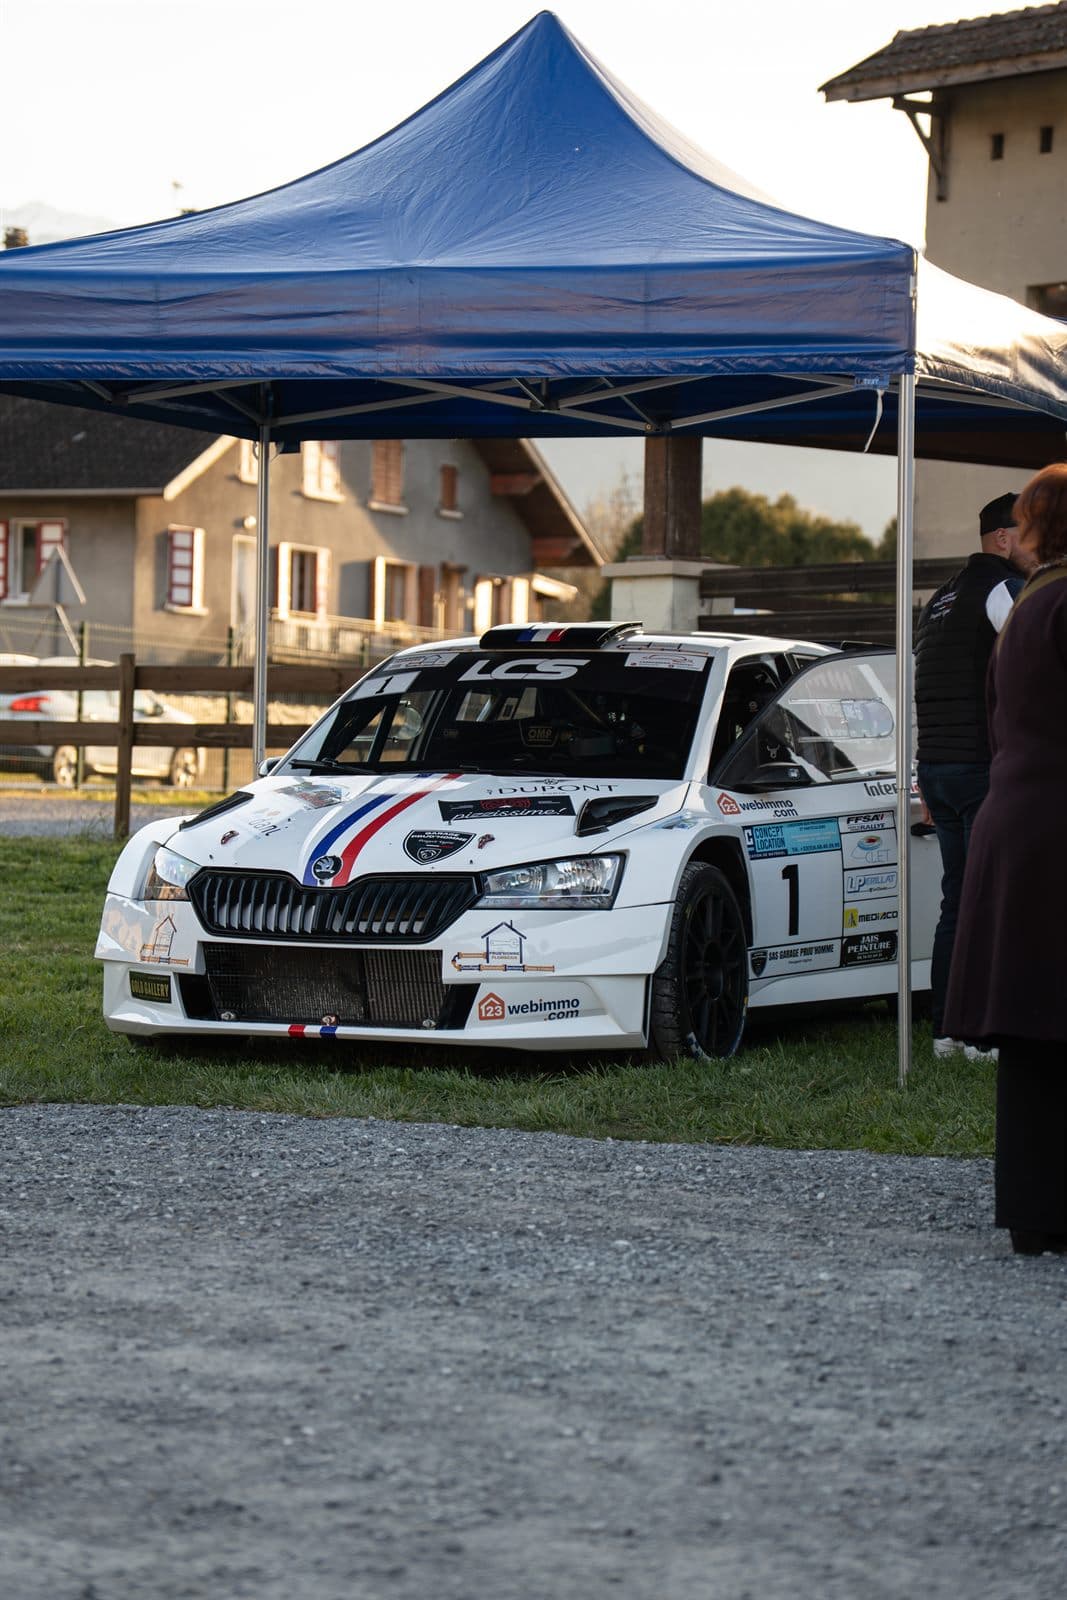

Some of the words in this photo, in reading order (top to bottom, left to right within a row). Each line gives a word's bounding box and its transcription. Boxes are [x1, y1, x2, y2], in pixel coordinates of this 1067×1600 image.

[457, 658, 591, 681] LCS
[374, 675, 394, 695] 1
[498, 784, 618, 795] DUPONT
[740, 799, 793, 811] webimmo
[754, 826, 784, 839] CONCEPT
[756, 838, 787, 851] LOCATION
[782, 864, 799, 936] 1
[862, 934, 879, 944] JAIS
[780, 948, 799, 960] GARAGE
[847, 942, 890, 954] PEINTURE
[144, 981, 169, 998] GALLERY
[481, 1004, 502, 1016] 123
[508, 998, 580, 1015] webimmo
[543, 1009, 579, 1022] .com
